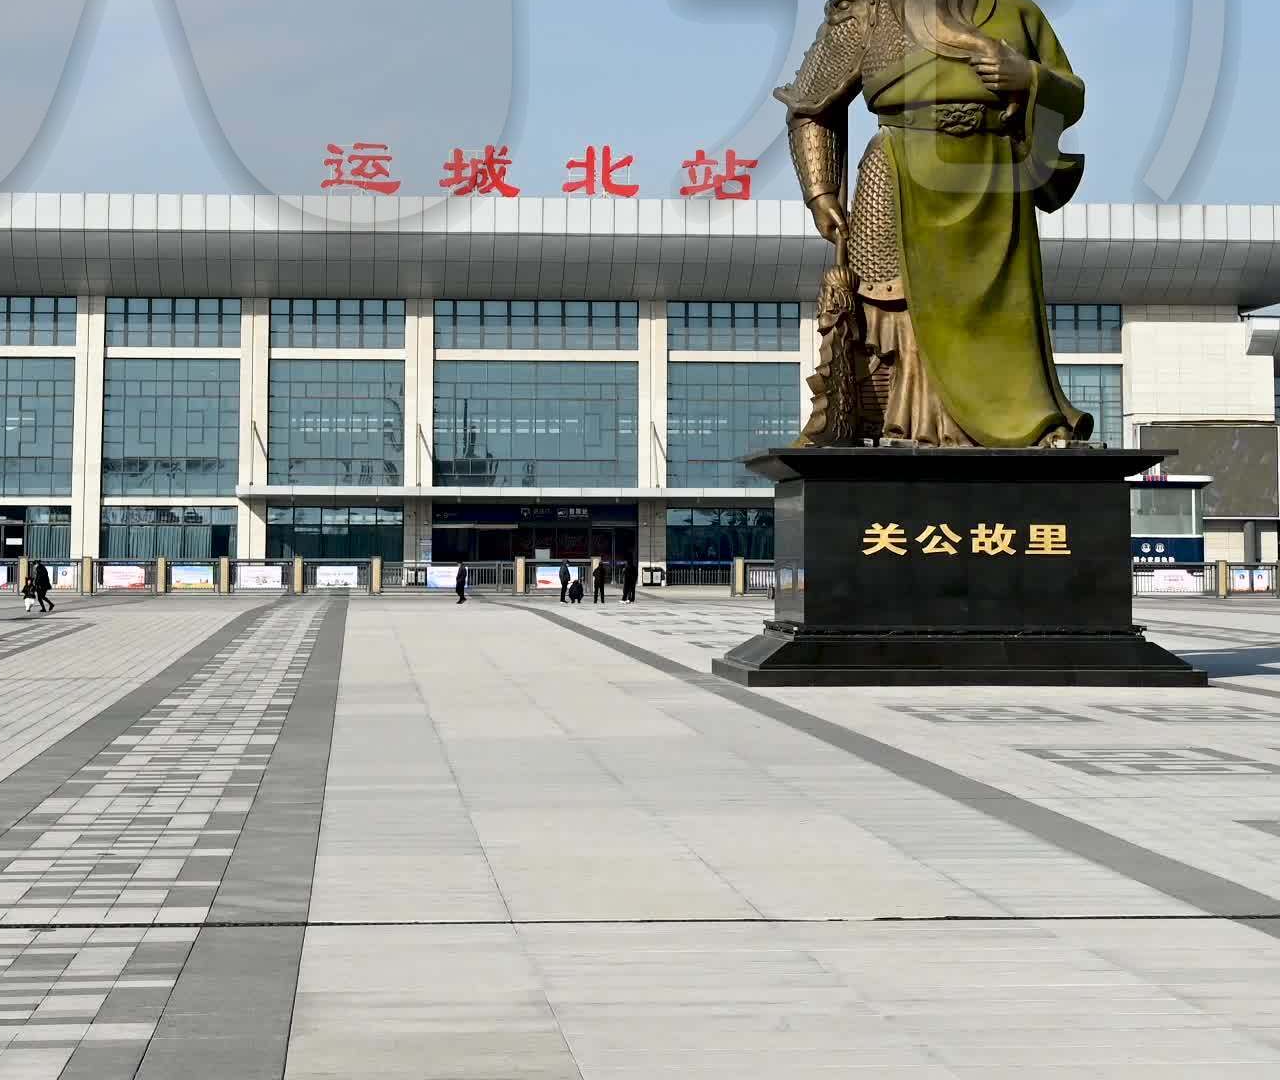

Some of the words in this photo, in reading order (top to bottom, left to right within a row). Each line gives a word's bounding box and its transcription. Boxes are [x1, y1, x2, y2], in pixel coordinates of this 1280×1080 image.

[320, 142, 758, 200] 运城北站
[862, 522, 1072, 556] 关公故里
